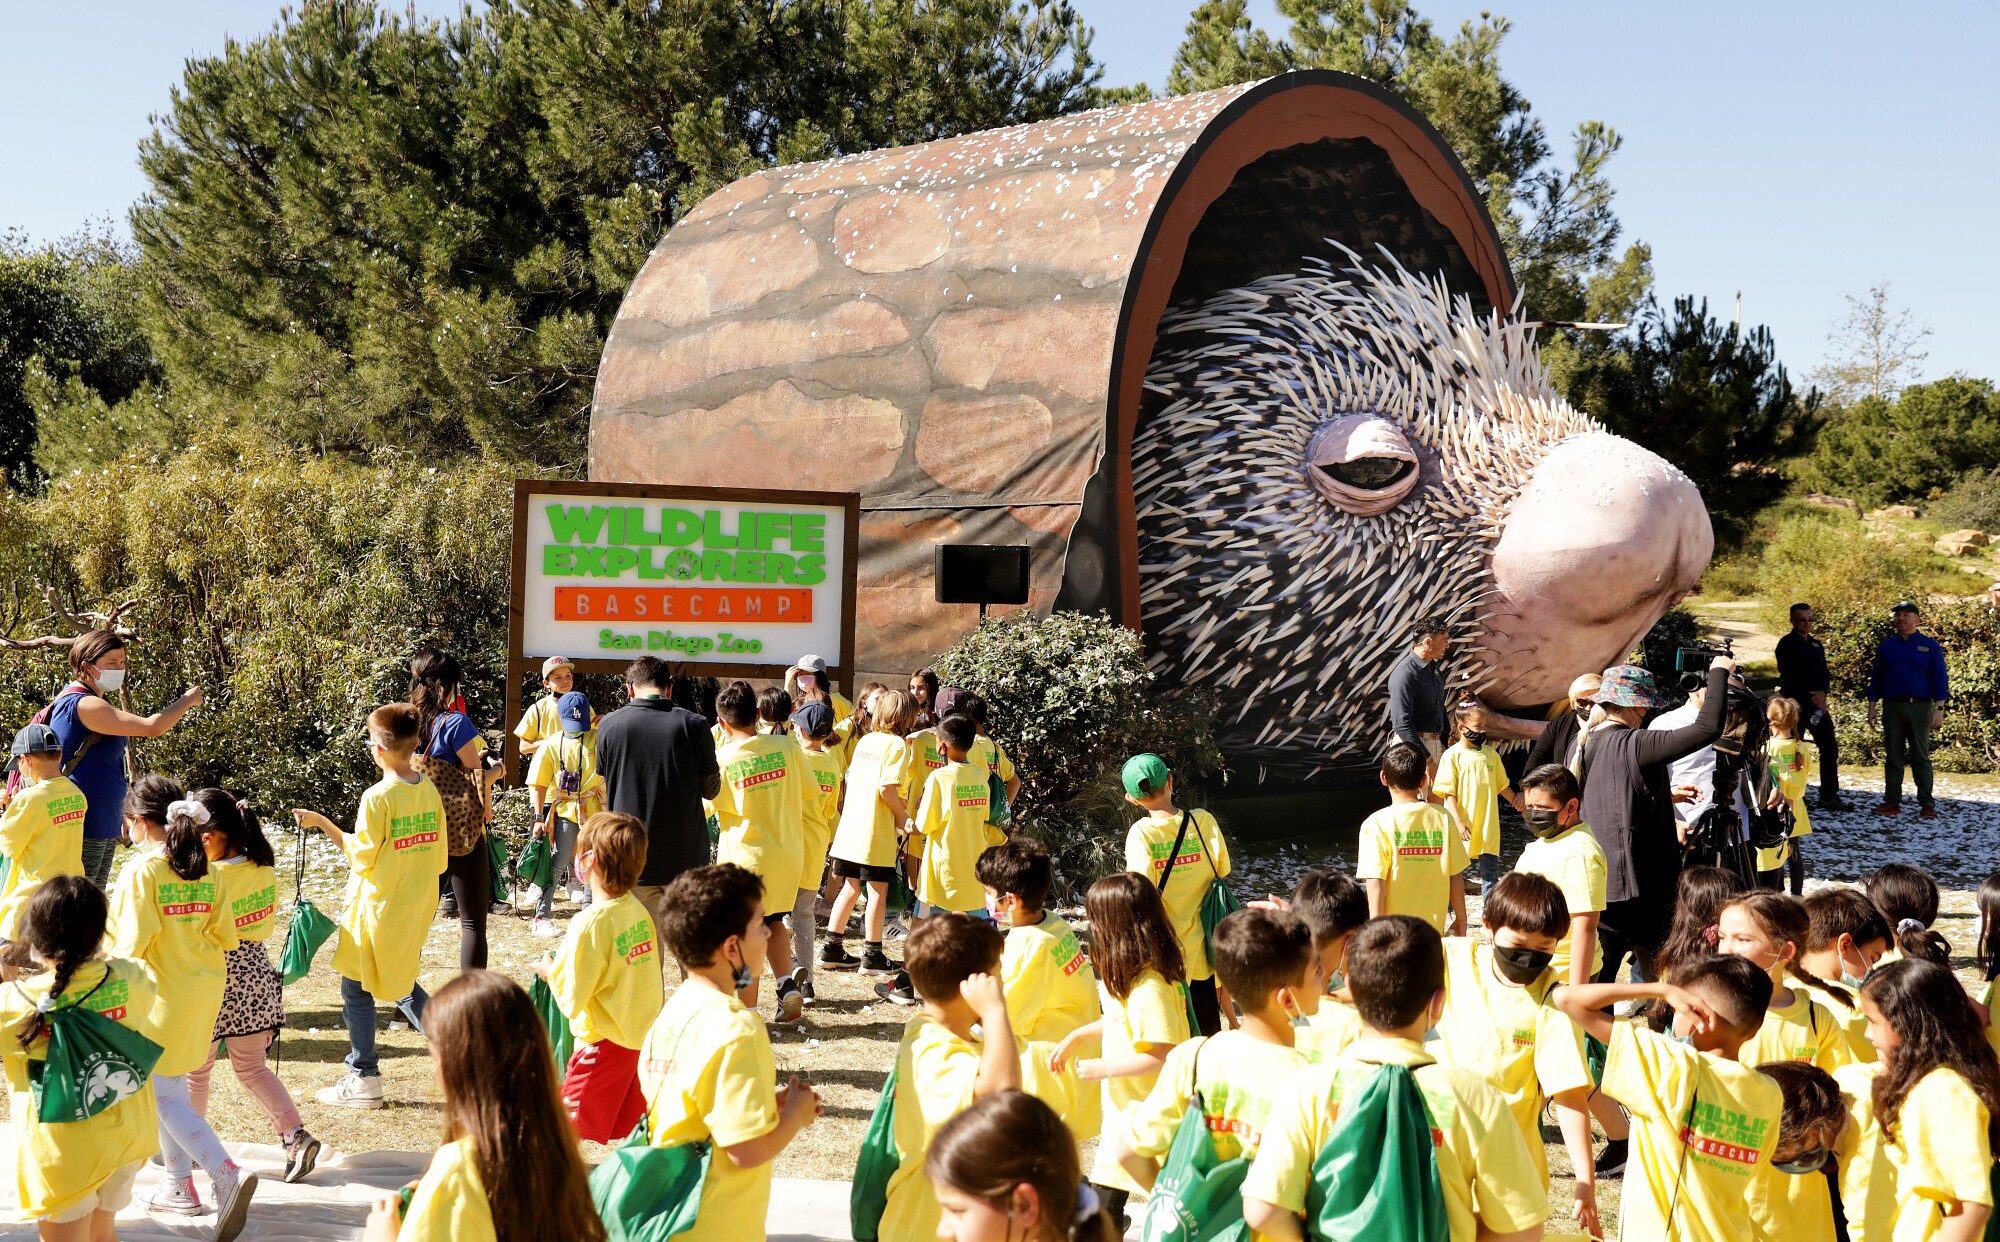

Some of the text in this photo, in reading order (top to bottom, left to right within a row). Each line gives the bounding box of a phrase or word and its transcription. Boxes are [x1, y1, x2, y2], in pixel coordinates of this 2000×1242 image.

[545, 504, 826, 551] WILDLIFE
[543, 545, 826, 584] EXPLORERS
[576, 593, 791, 616] BASECAMP
[598, 629, 763, 656] San Diego Zoo
[573, 707, 582, 719] LA
[158, 882, 215, 894] WILDLIFE
[1693, 1100, 1768, 1135] WILDLIF
